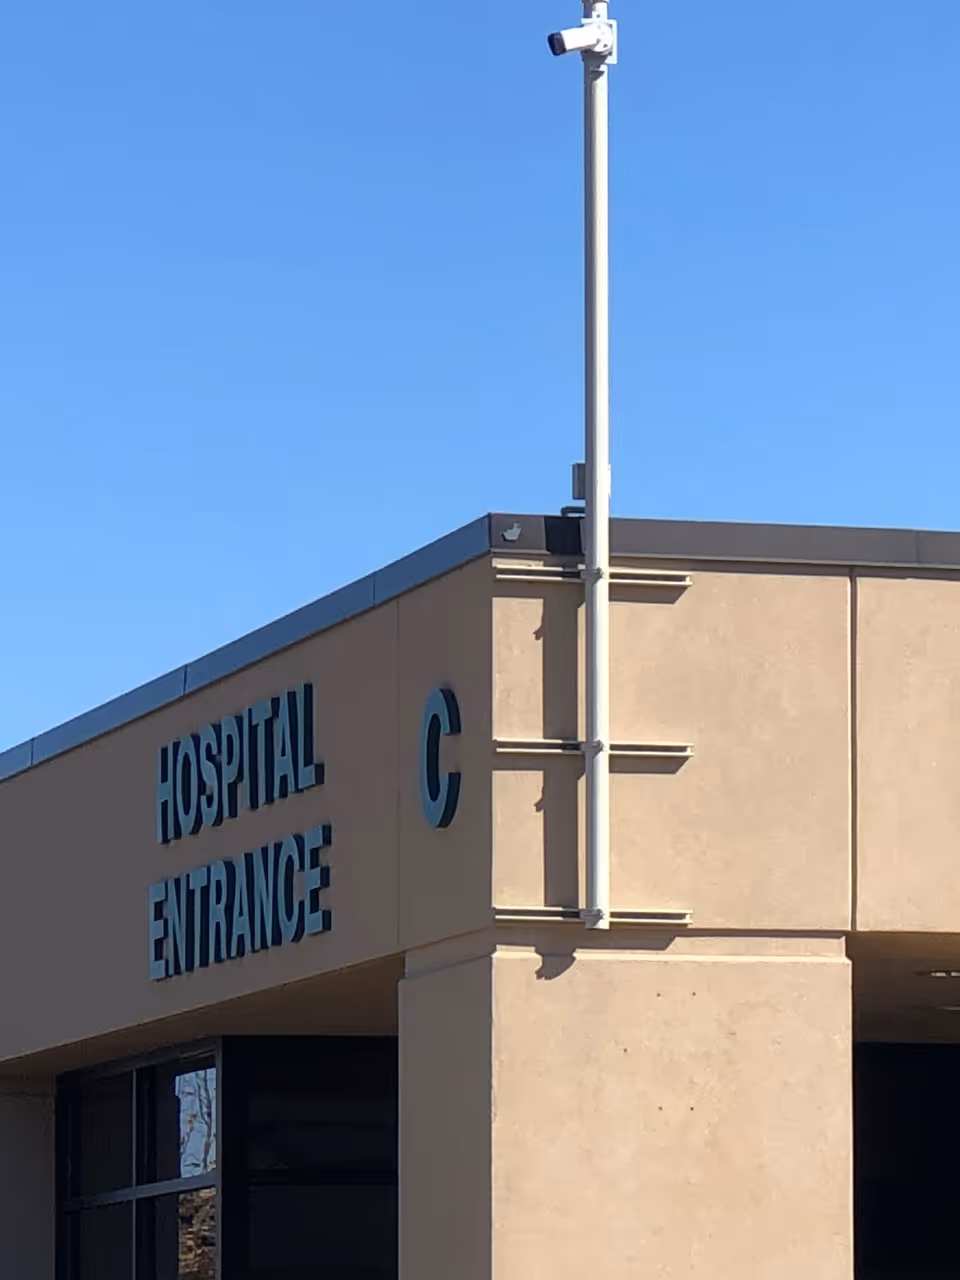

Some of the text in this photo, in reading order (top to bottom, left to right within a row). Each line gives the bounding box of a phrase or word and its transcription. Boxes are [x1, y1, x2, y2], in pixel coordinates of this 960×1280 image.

[157, 682, 325, 845] HOSPITAL
[419, 688, 462, 828] C
[149, 824, 332, 981] ENTRANCE
